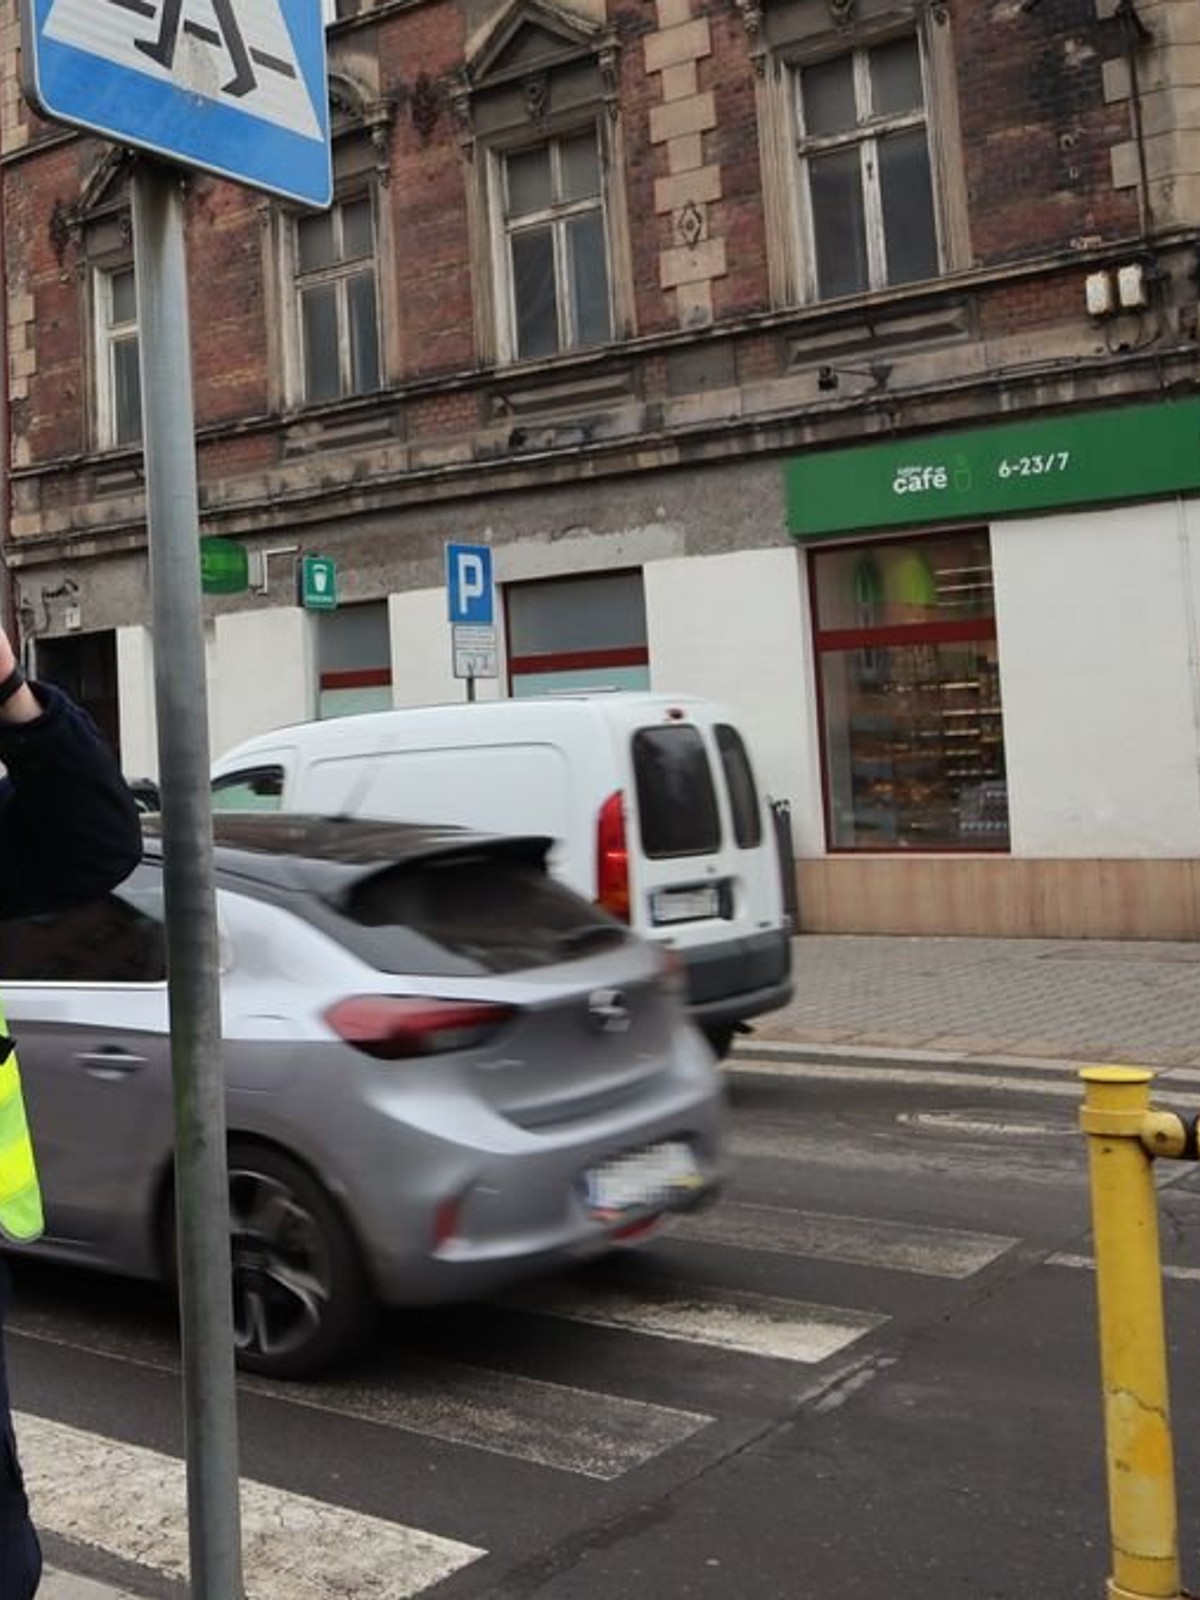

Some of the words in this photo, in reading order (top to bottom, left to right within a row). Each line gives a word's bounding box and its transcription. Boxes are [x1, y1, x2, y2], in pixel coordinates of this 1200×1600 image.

[998, 451, 1069, 478] 6-23/7
[893, 466, 948, 495] café
[457, 552, 484, 614] P
